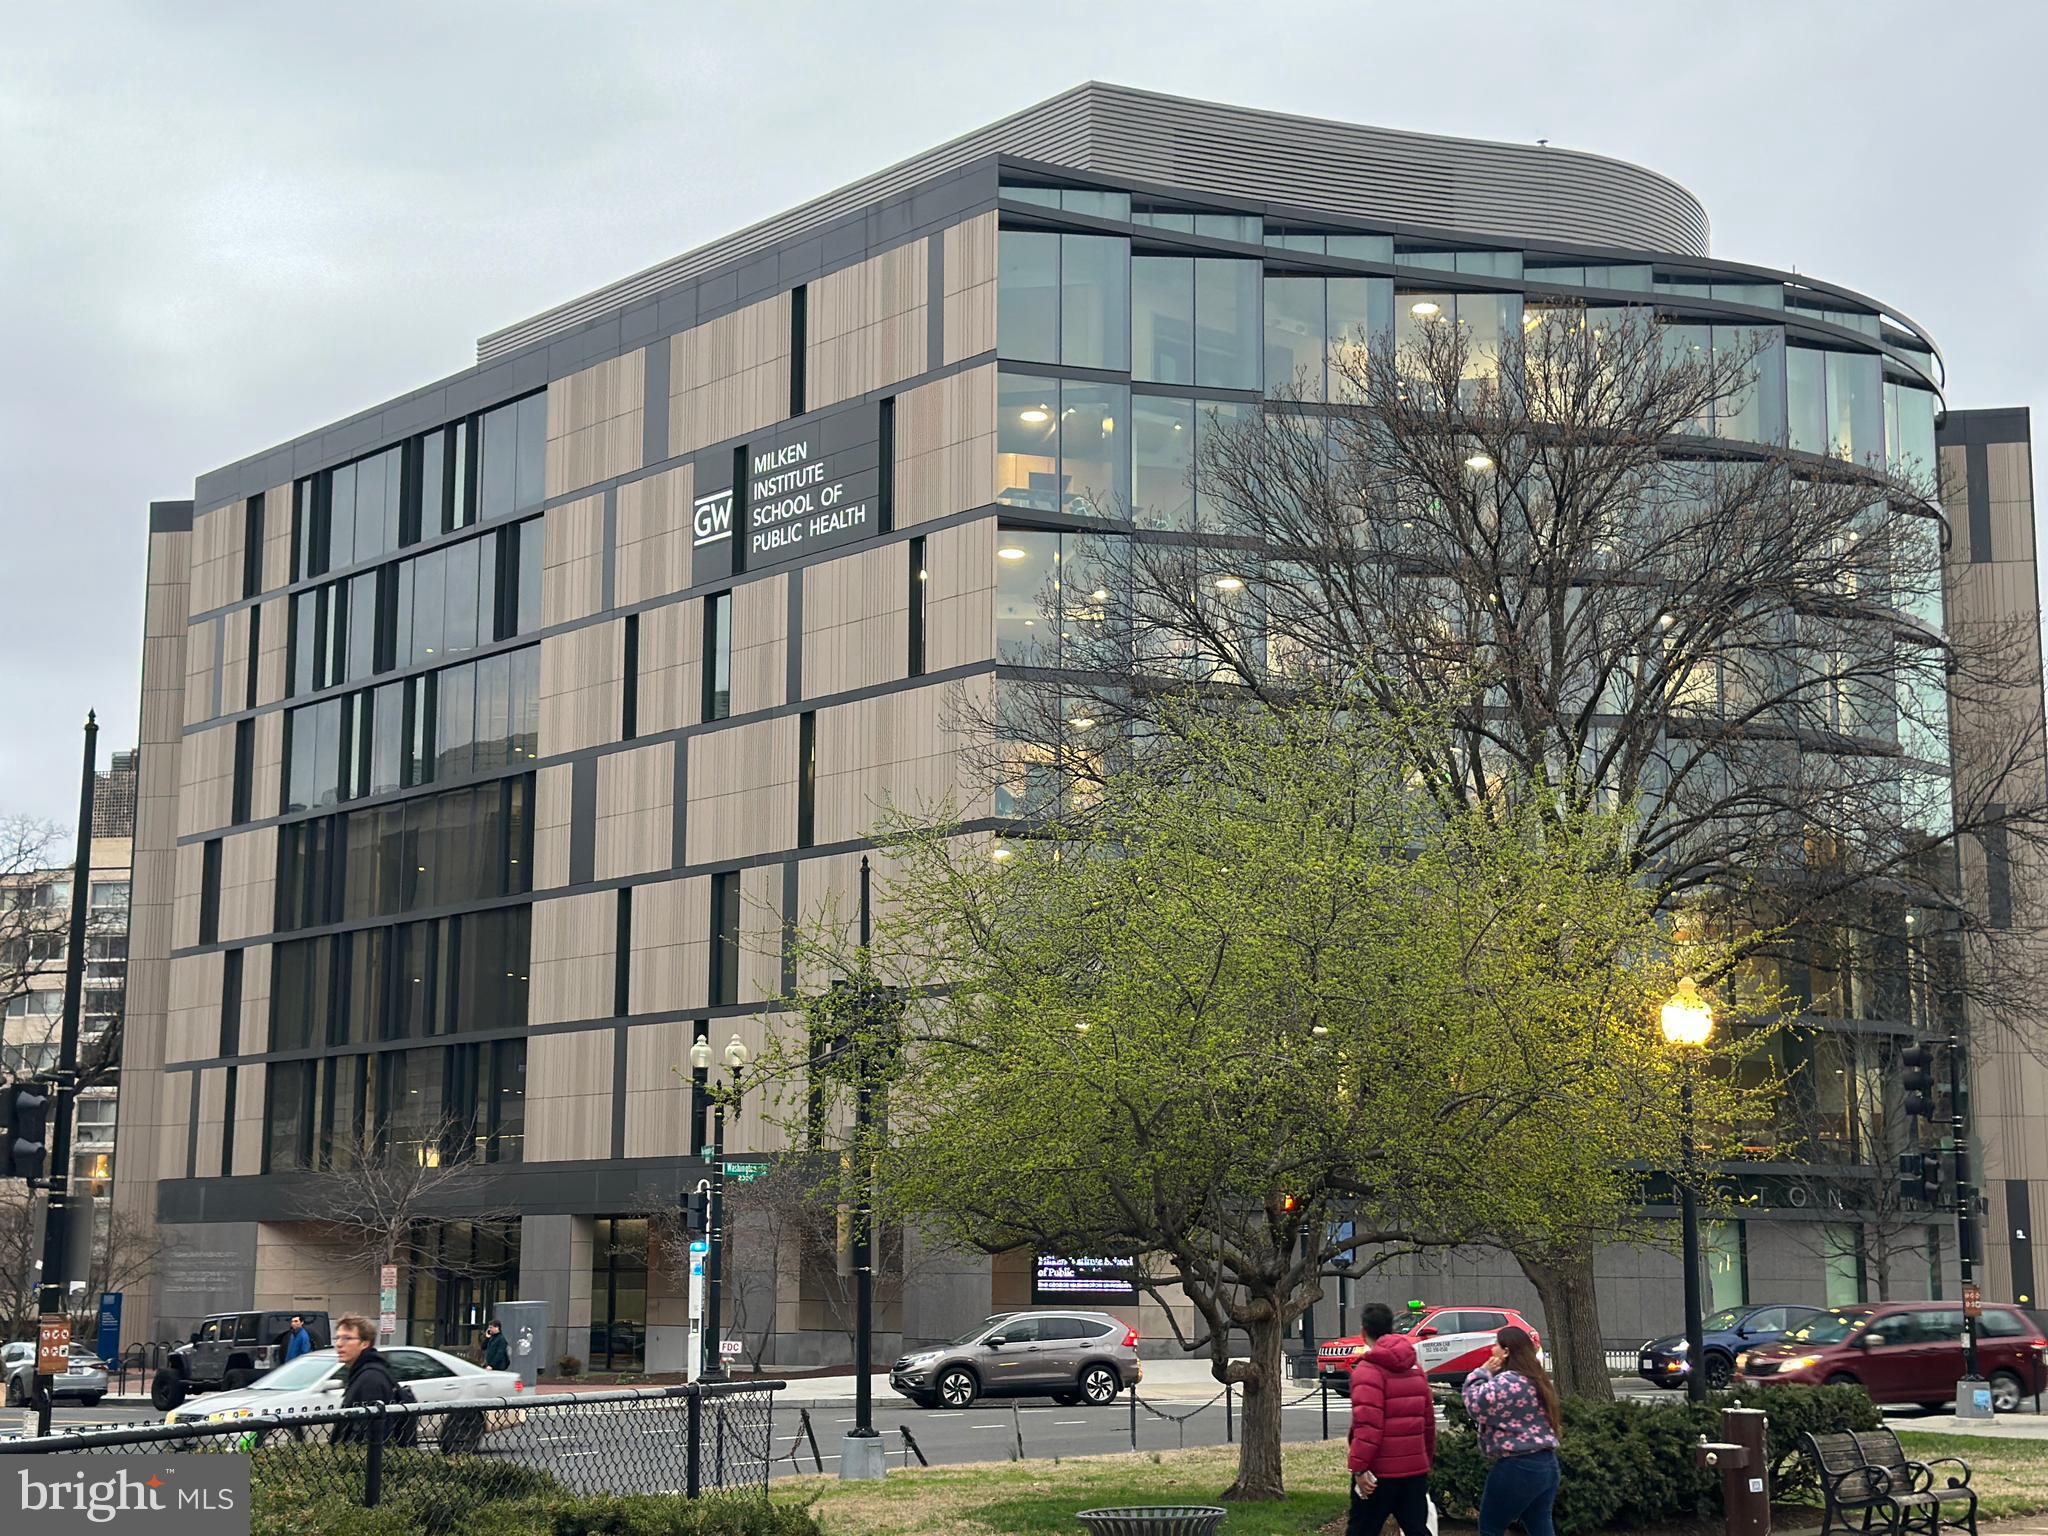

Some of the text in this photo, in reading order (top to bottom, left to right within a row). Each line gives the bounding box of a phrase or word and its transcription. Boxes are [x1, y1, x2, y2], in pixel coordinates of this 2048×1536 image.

[754, 441, 807, 474] MILKEN
[753, 462, 824, 500] INSTITUTE
[694, 497, 733, 537] GW
[753, 484, 843, 527] SCHOOL OF
[753, 504, 866, 554] PUBLIC HEALTH
[1047, 1267, 1075, 1277] Public
[722, 1343, 739, 1352] FDC
